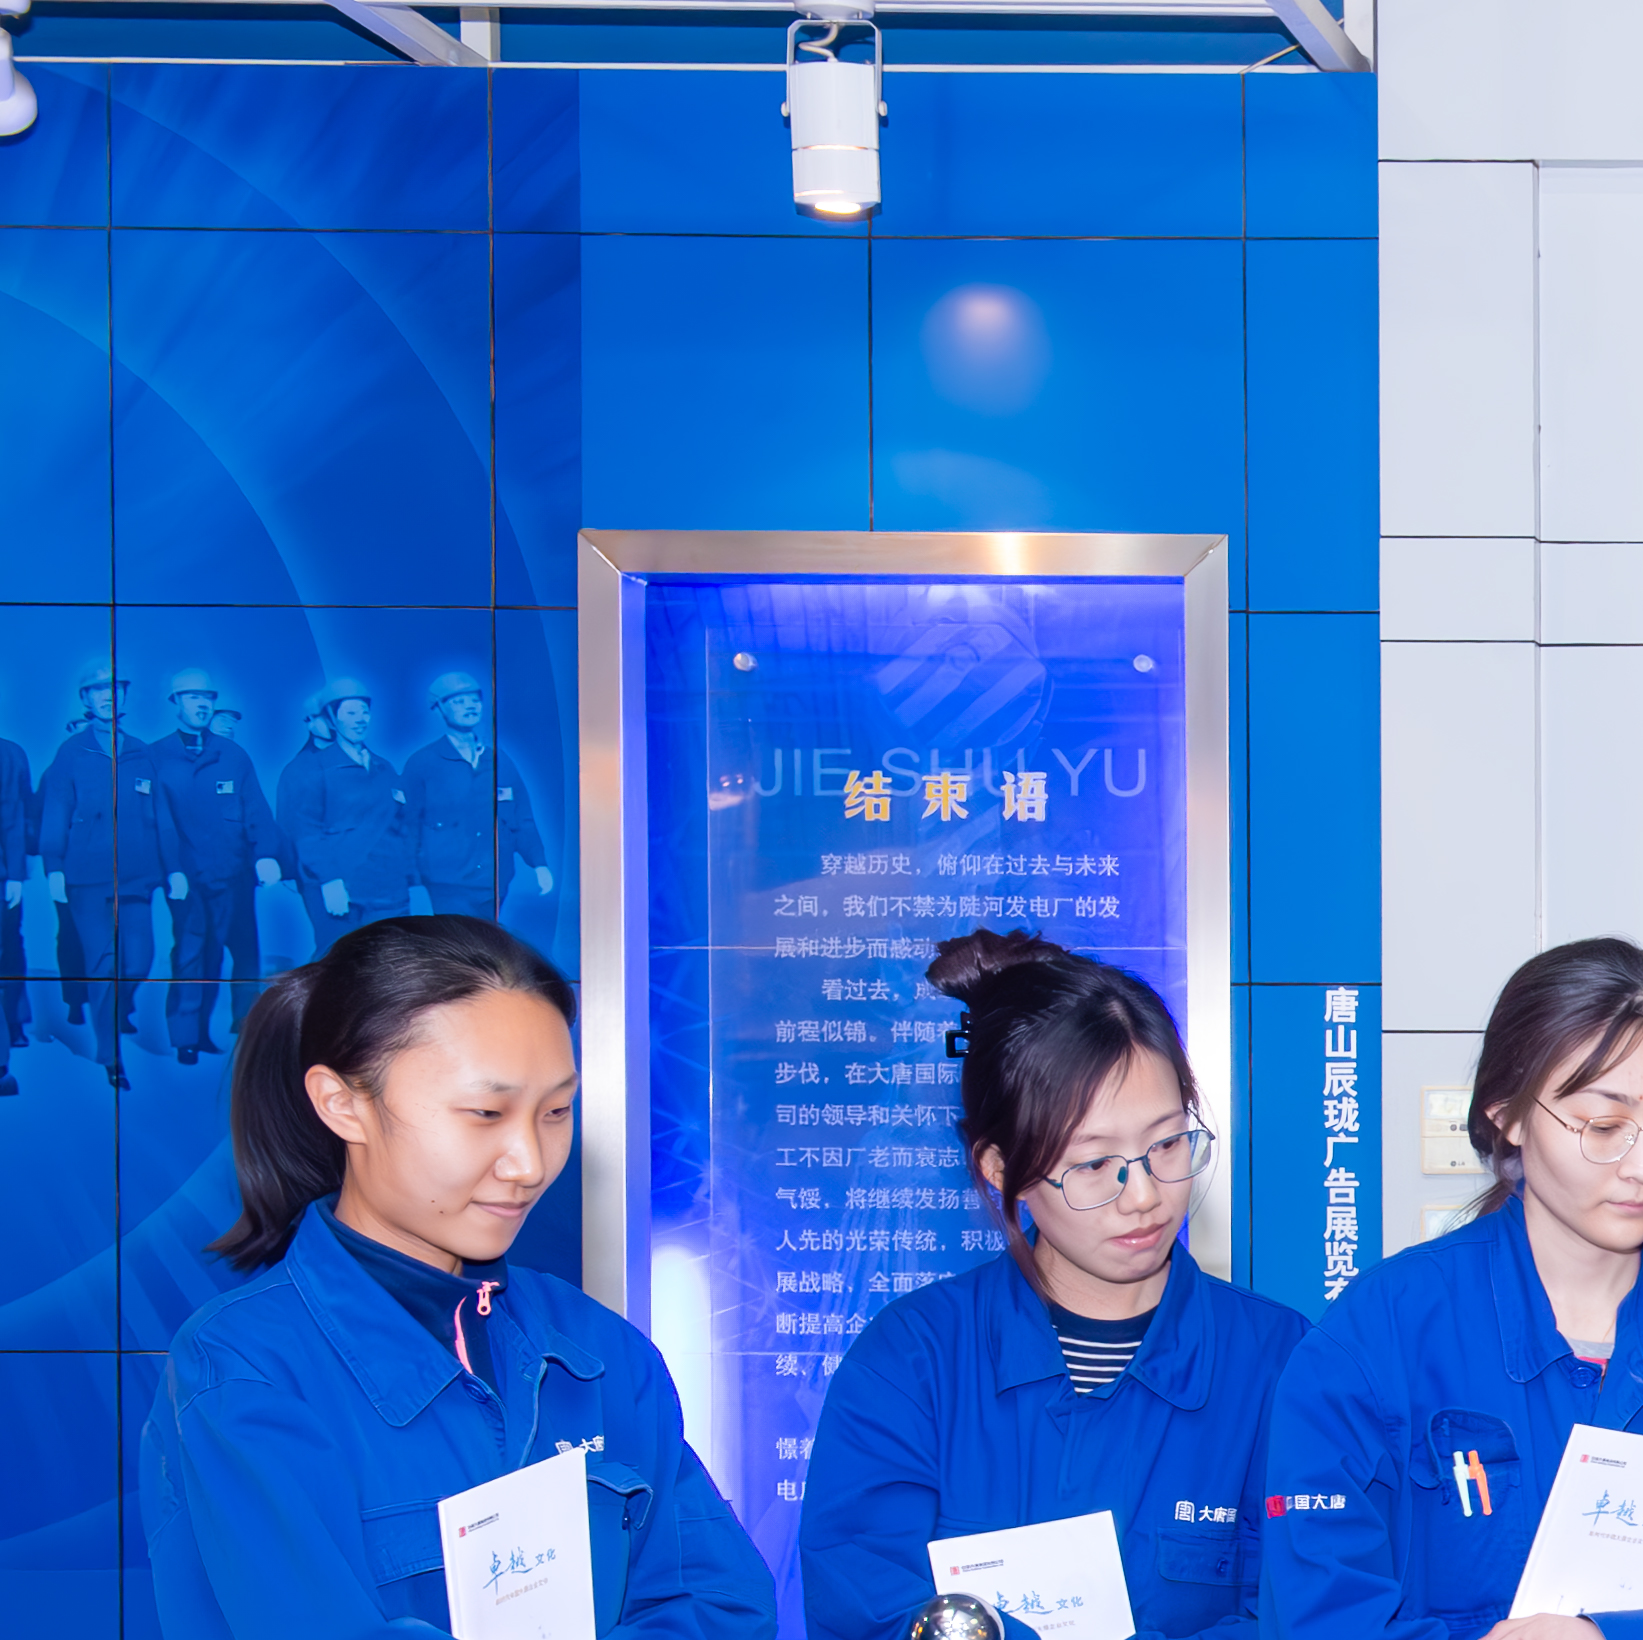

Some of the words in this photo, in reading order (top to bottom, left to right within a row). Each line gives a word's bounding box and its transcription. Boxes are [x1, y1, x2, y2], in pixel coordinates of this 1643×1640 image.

[754, 747, 852, 798] JIE
[1050, 747, 1147, 799] YU
[843, 769, 1049, 823] 结束语
[820, 853, 1121, 877] 穿越历史，俯仰在过去与未来
